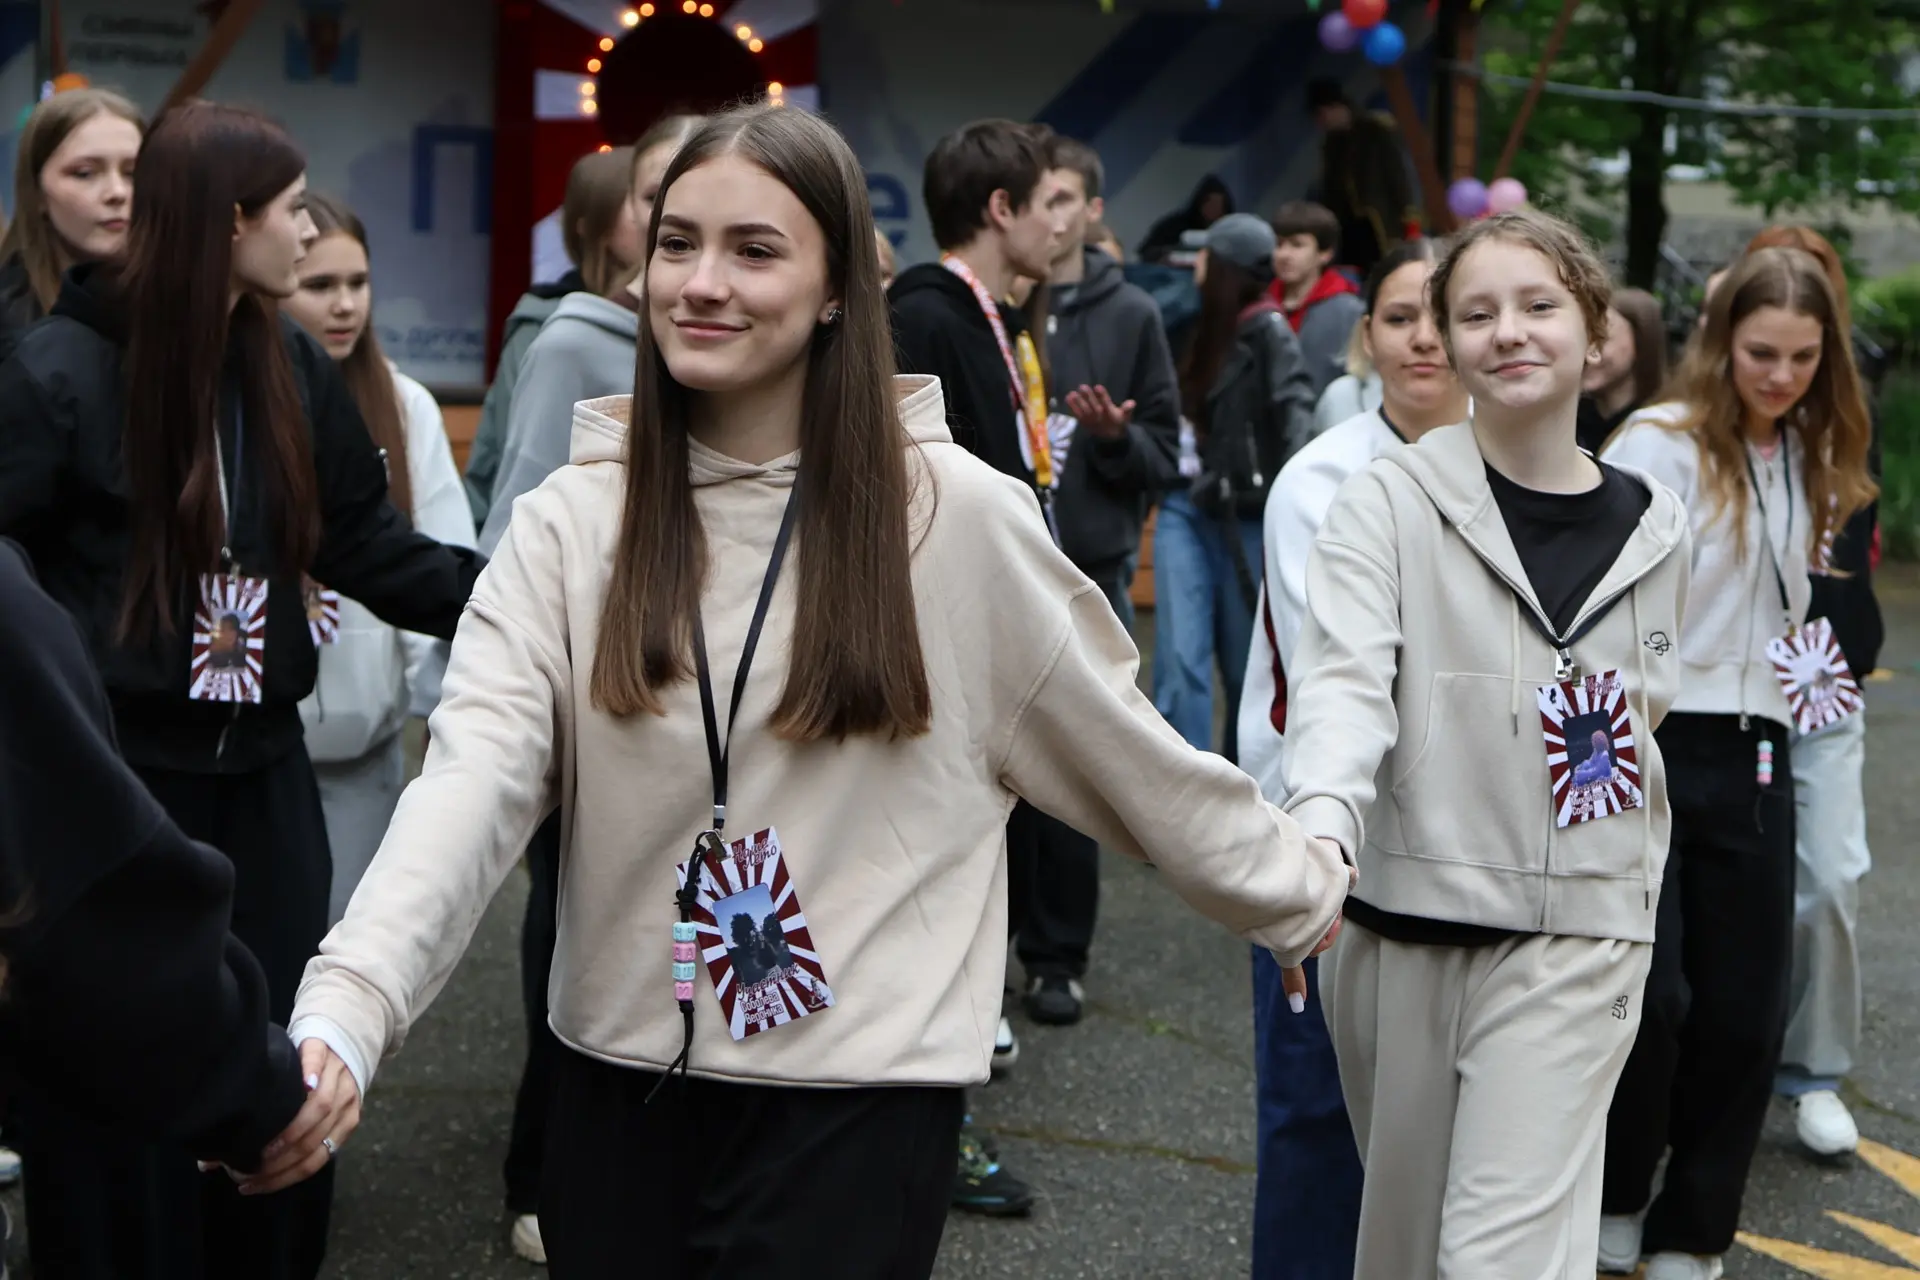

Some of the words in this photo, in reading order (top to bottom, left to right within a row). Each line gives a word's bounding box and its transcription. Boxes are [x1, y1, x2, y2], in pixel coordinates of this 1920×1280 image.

[736, 962, 800, 1001] Участник
[740, 991, 781, 1013] Соболева
[744, 1003, 785, 1025] Вероника
